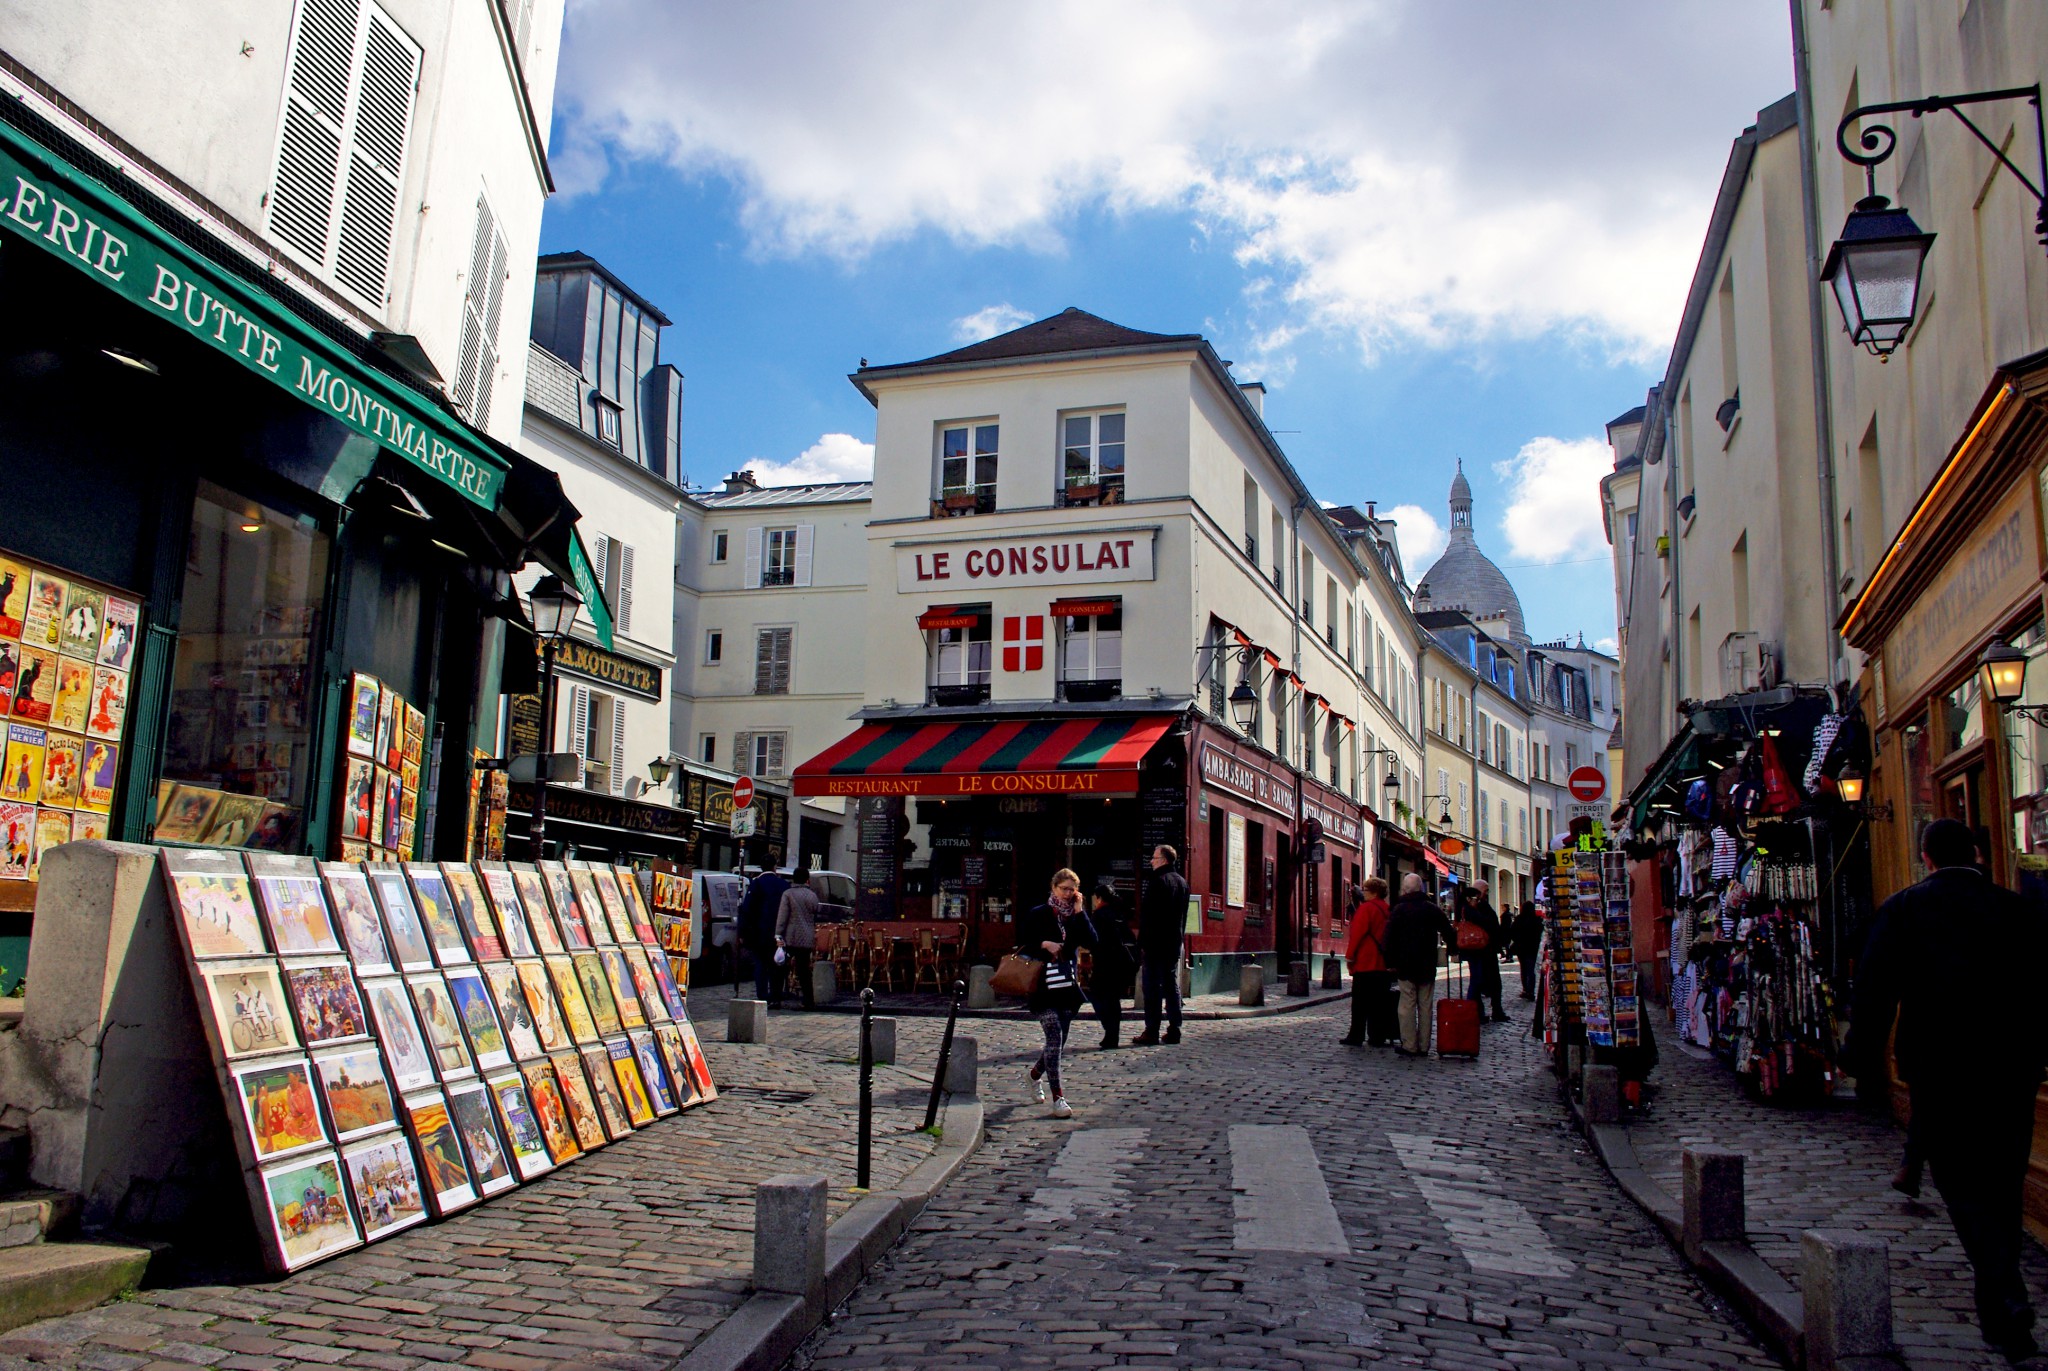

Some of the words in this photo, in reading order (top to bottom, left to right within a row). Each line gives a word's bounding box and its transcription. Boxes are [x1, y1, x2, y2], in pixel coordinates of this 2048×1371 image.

[148, 263, 282, 374] BUTTE
[296, 355, 492, 500] MONTMARTRE
[915, 552, 950, 581] LE
[965, 539, 1134, 579] CONSULAT
[1924, 510, 2022, 649] MONTMARTRE
[1069, 605, 1105, 613] CONSULAT
[927, 618, 968, 627] RESTAURANT
[12, 726, 44, 737] CHOCOLAT
[10, 733, 45, 746] MENIER
[1204, 752, 1254, 793] AMBASSADE
[1259, 777, 1268, 799] DE
[829, 780, 921, 793] RESTAURANT
[958, 776, 982, 792] LE
[991, 773, 1098, 791] CONSULAT
[91, 789, 110, 801] MAGGI
[509, 790, 612, 825] ESAURANT
[736, 810, 749, 819] SAUF
[611, 1050, 631, 1061] ENIER
